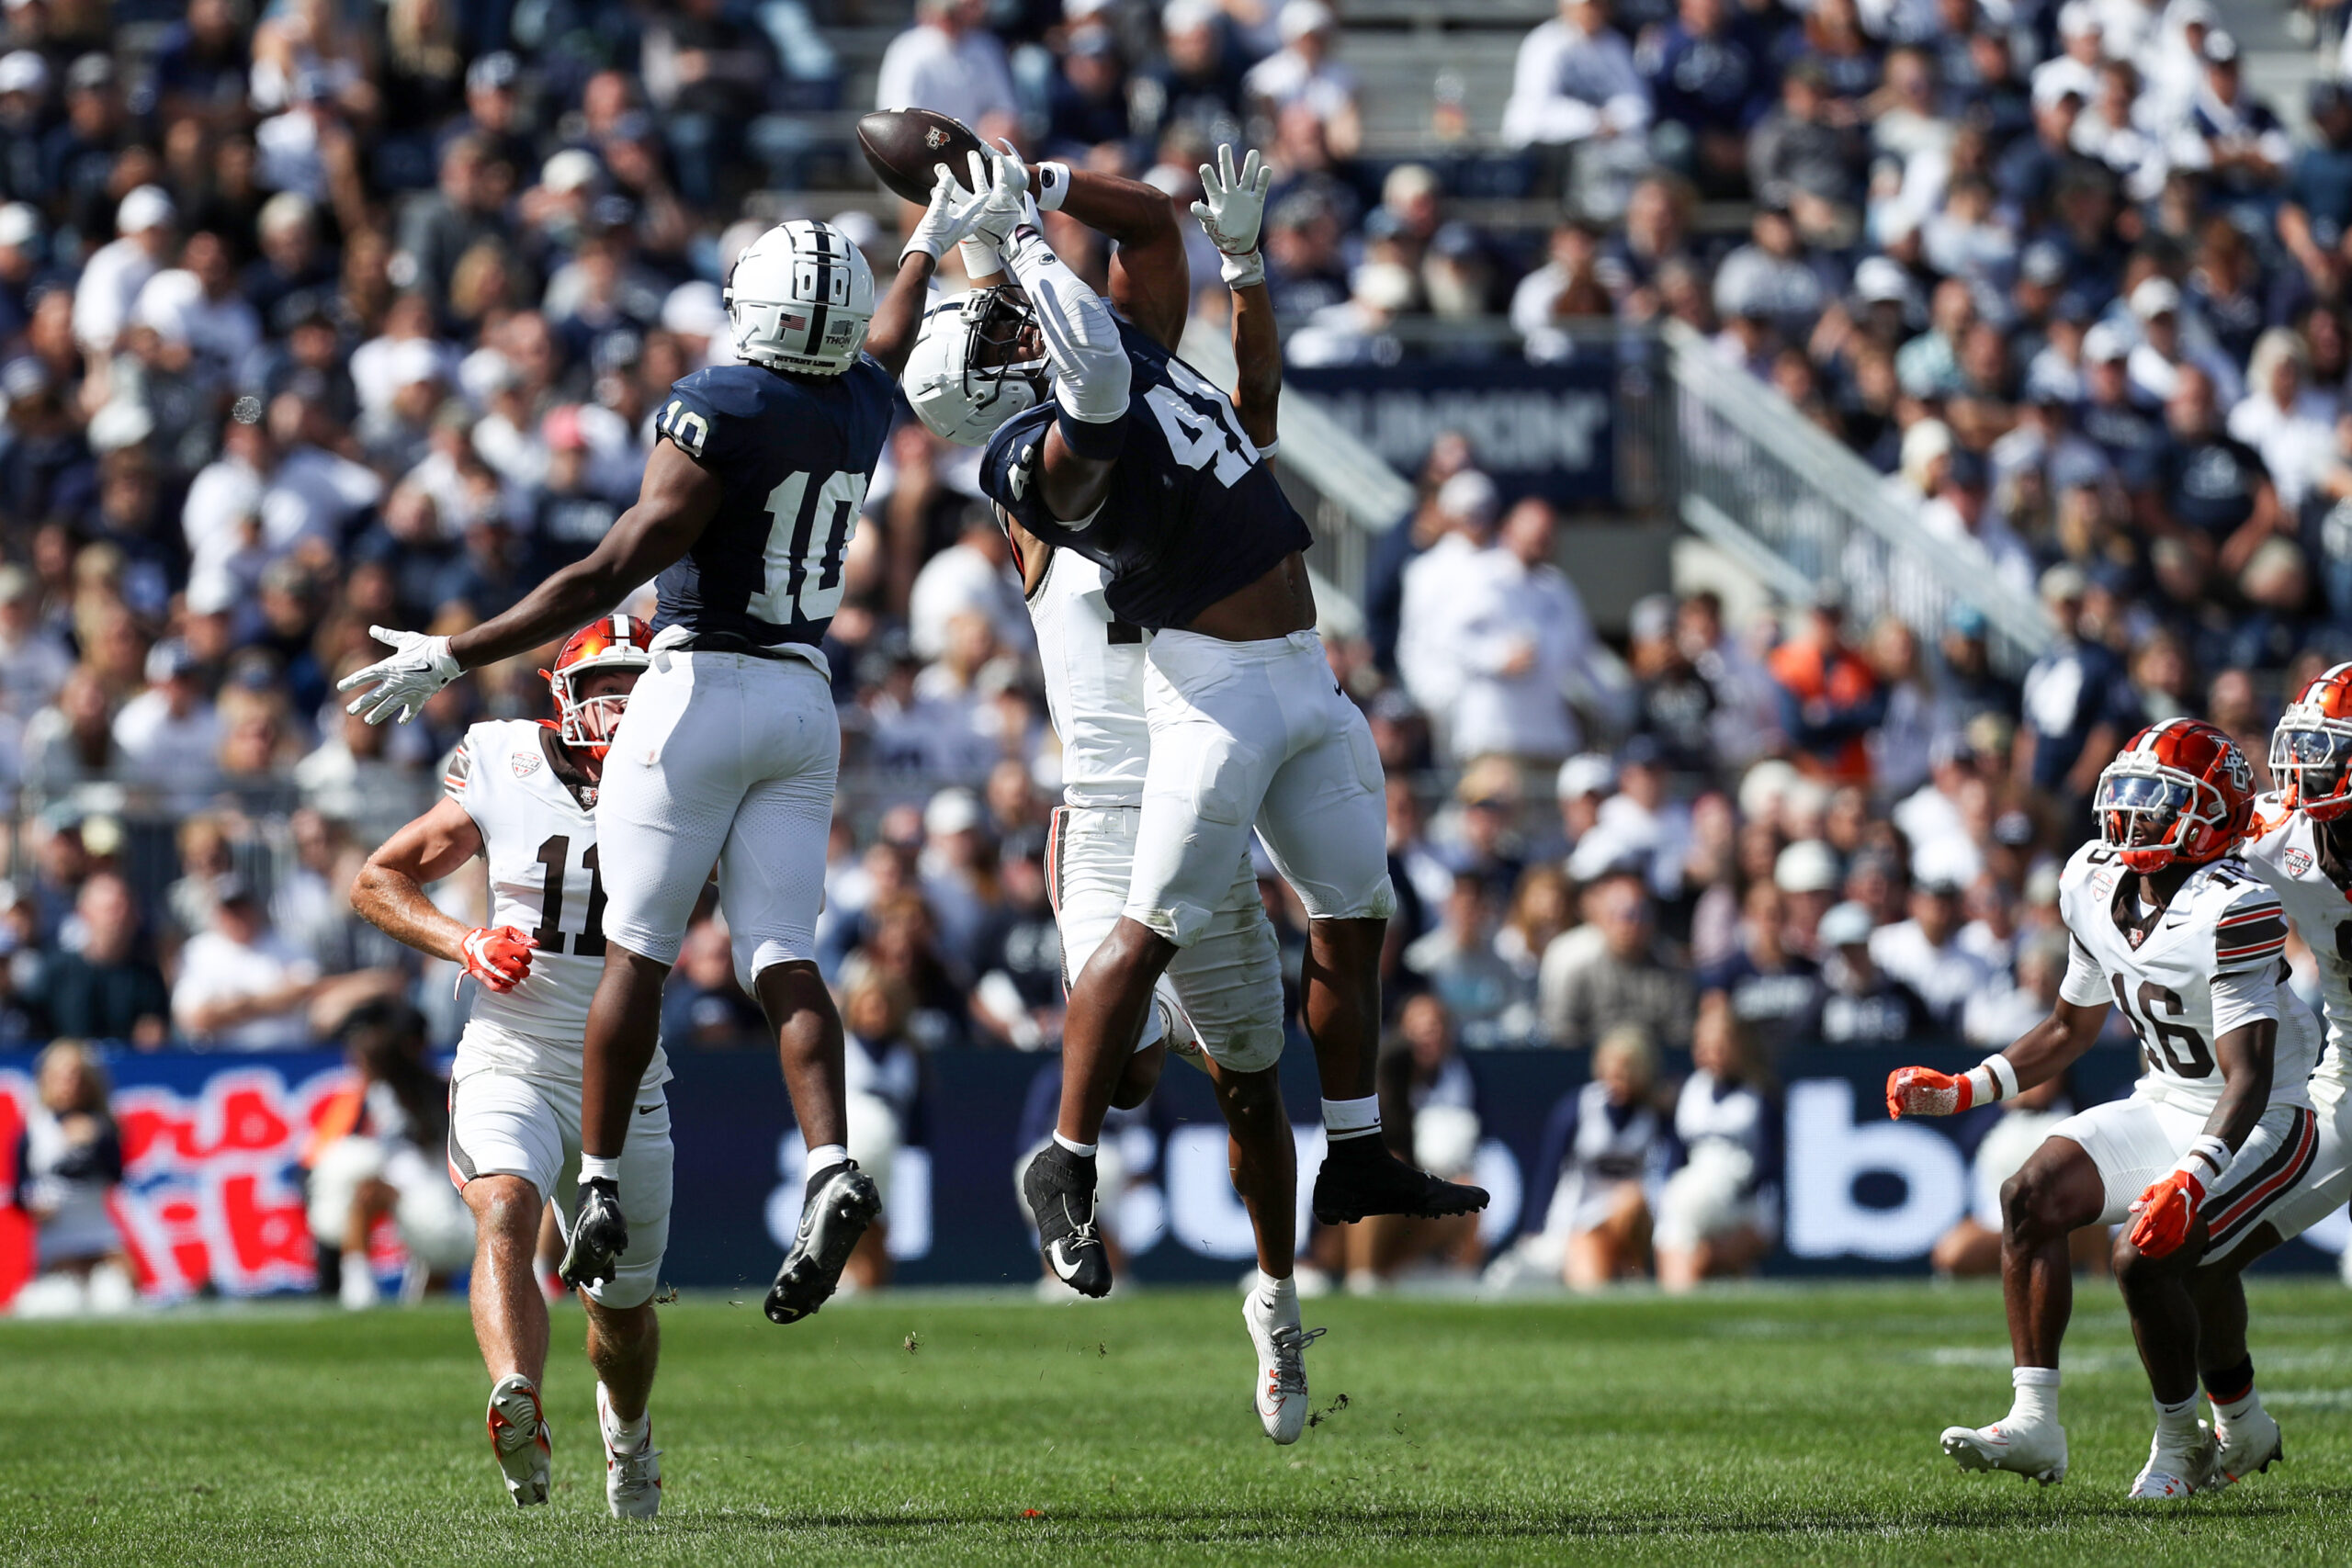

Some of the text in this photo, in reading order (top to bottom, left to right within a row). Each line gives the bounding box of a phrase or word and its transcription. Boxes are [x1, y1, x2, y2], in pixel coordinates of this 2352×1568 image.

[826, 335, 851, 345] THON
[662, 400, 709, 457] 10
[746, 470, 867, 625] 10
[533, 835, 608, 956] 11
[2111, 973, 2215, 1078] 16
